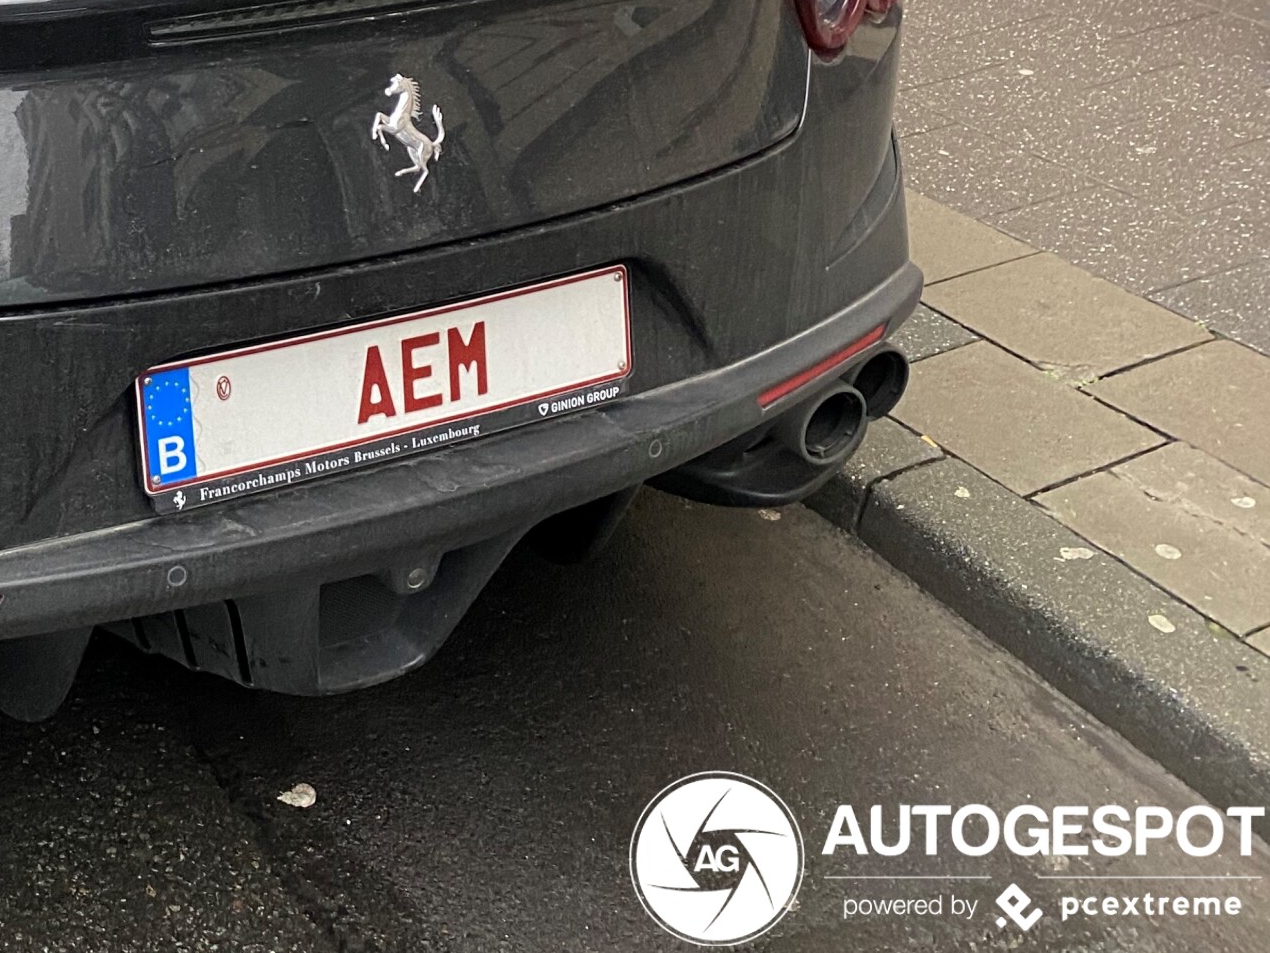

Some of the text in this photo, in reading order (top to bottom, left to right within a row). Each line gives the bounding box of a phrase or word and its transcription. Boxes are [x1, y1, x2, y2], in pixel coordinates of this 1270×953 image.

[358, 321, 488, 425] AEM
[551, 386, 620, 413] GINION GROUP
[157, 436, 187, 475] B
[199, 467, 301, 501] Francorchamps
[304, 454, 350, 476] Motors
[354, 442, 401, 464] Brussels
[412, 424, 481, 449] Luxembourg
